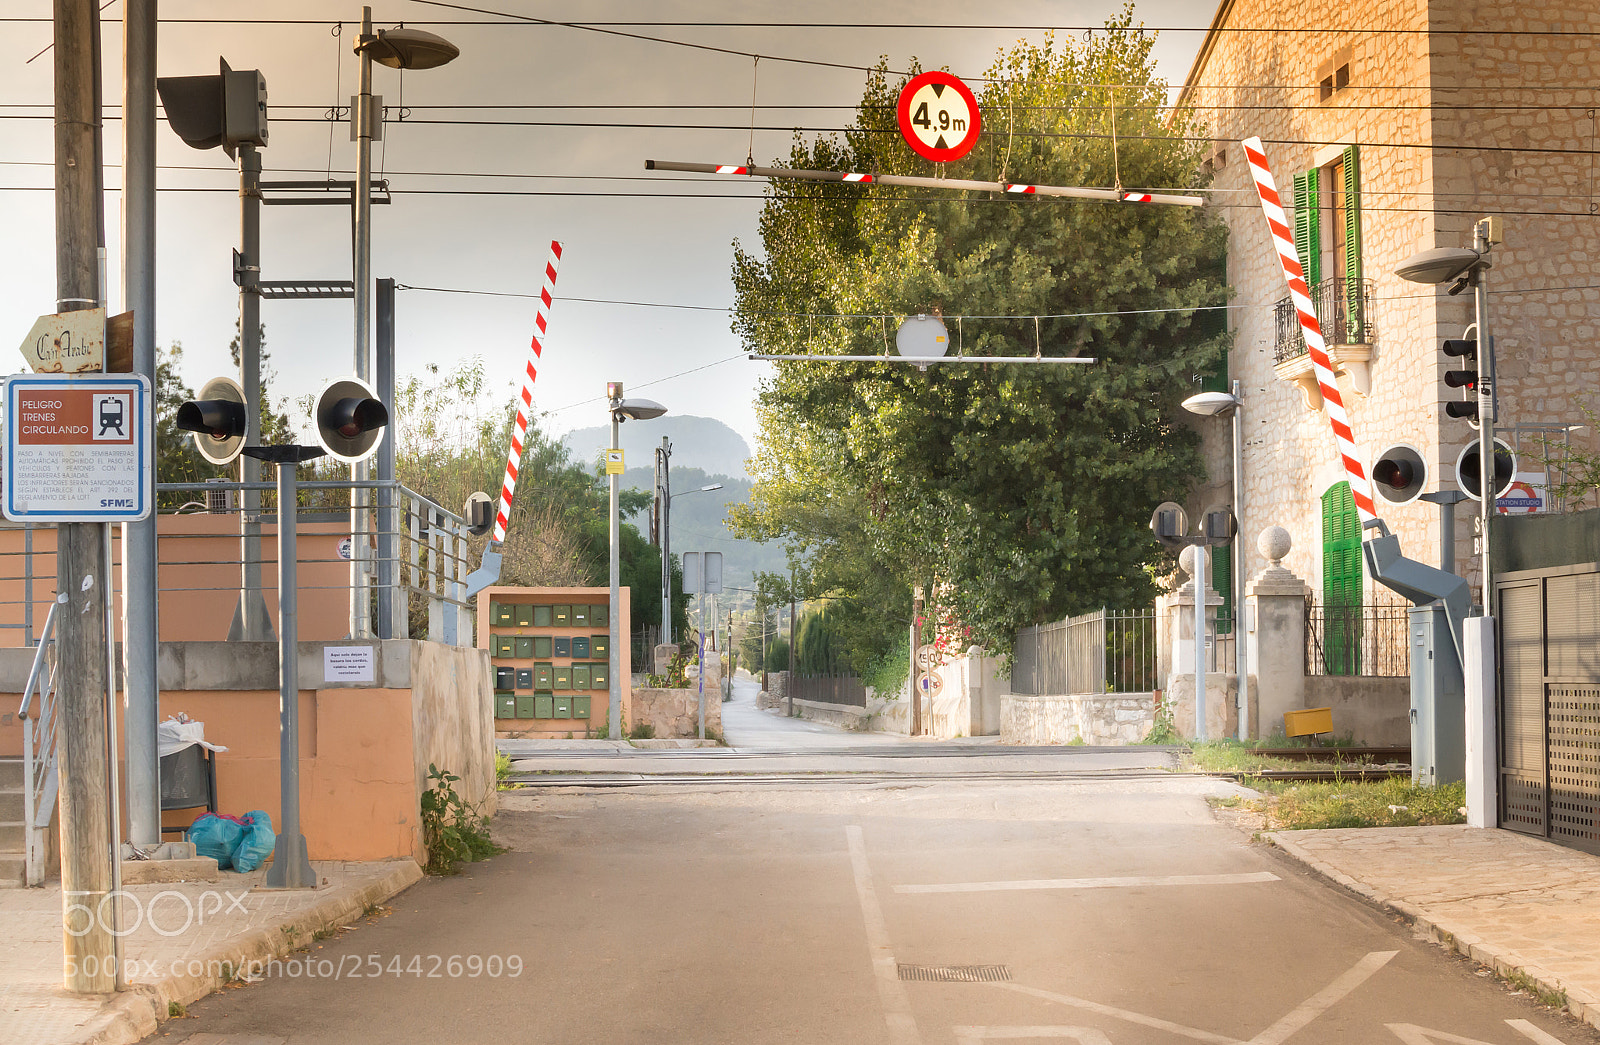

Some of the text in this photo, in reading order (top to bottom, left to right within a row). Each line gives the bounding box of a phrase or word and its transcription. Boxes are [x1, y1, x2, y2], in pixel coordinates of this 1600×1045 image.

[22, 400, 63, 409] PELIGRO
[22, 412, 56, 422] TRENES
[22, 425, 89, 434] CIRCULANDO
[107, 457, 124, 465] PASO
[126, 457, 135, 465] DE
[100, 498, 125, 508] SFM
[1495, 498, 1541, 506] STATION STUDIO
